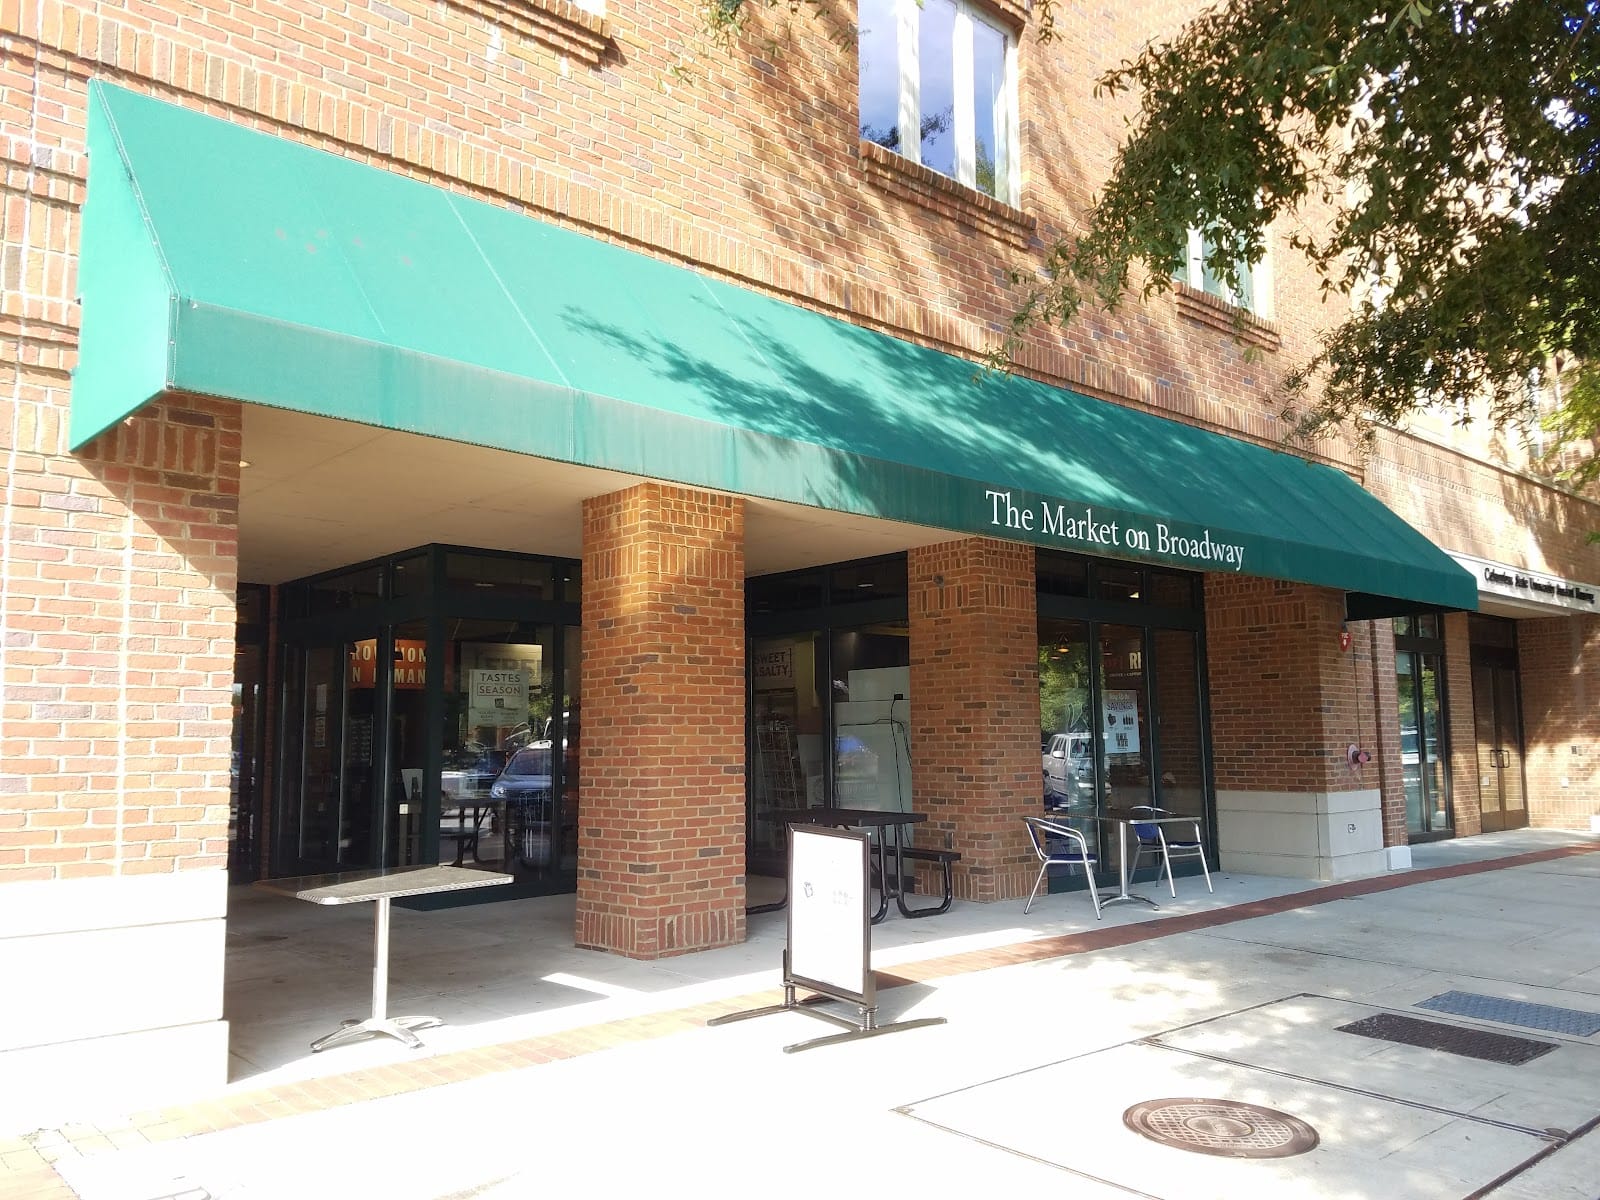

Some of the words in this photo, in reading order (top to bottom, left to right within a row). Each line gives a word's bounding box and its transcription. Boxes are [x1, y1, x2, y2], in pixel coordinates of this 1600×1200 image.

[985, 490, 1034, 531] The
[1041, 501, 1120, 546] Market
[1125, 528, 1151, 551] on
[1156, 523, 1245, 571] Broadway
[479, 672, 520, 683] TASTES
[479, 685, 521, 694] SEASON
